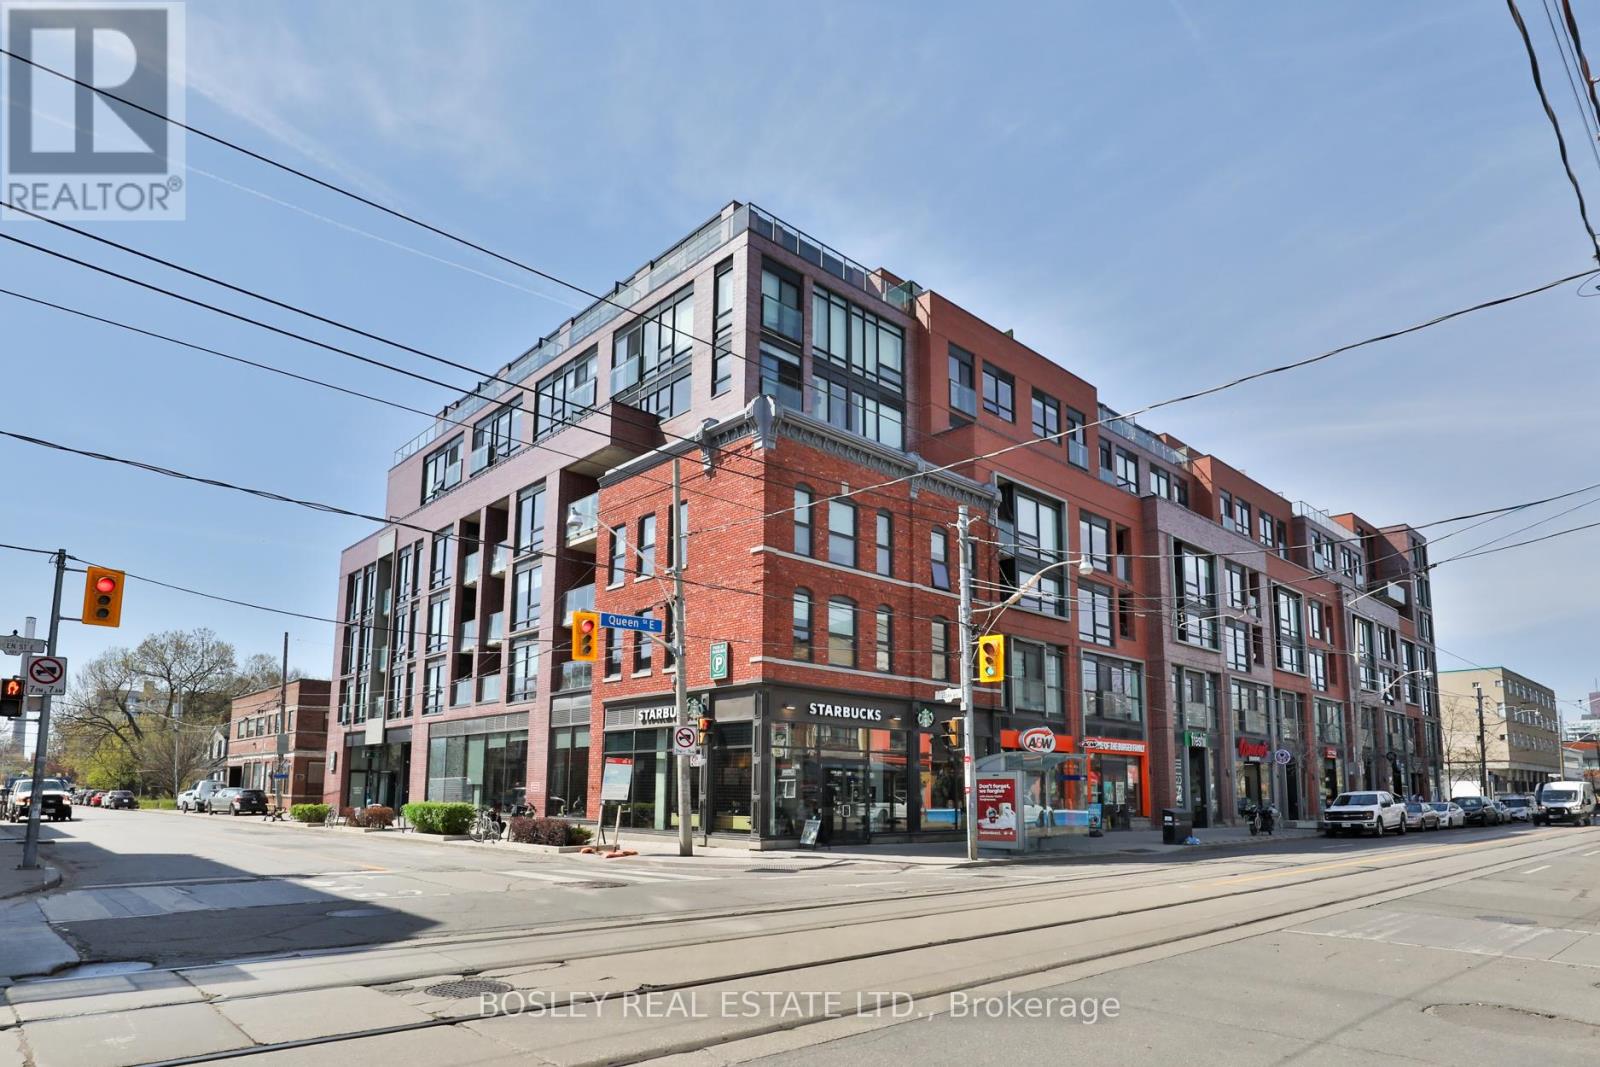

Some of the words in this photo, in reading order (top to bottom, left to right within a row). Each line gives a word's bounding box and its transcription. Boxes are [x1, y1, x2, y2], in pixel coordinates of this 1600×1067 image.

[608, 615, 639, 627] Queen
[649, 620, 655, 630] E
[715, 657, 723, 671] P
[638, 706, 677, 720] STARBU
[809, 702, 882, 720] STARBUCKS
[1028, 736, 1053, 750] A&W
